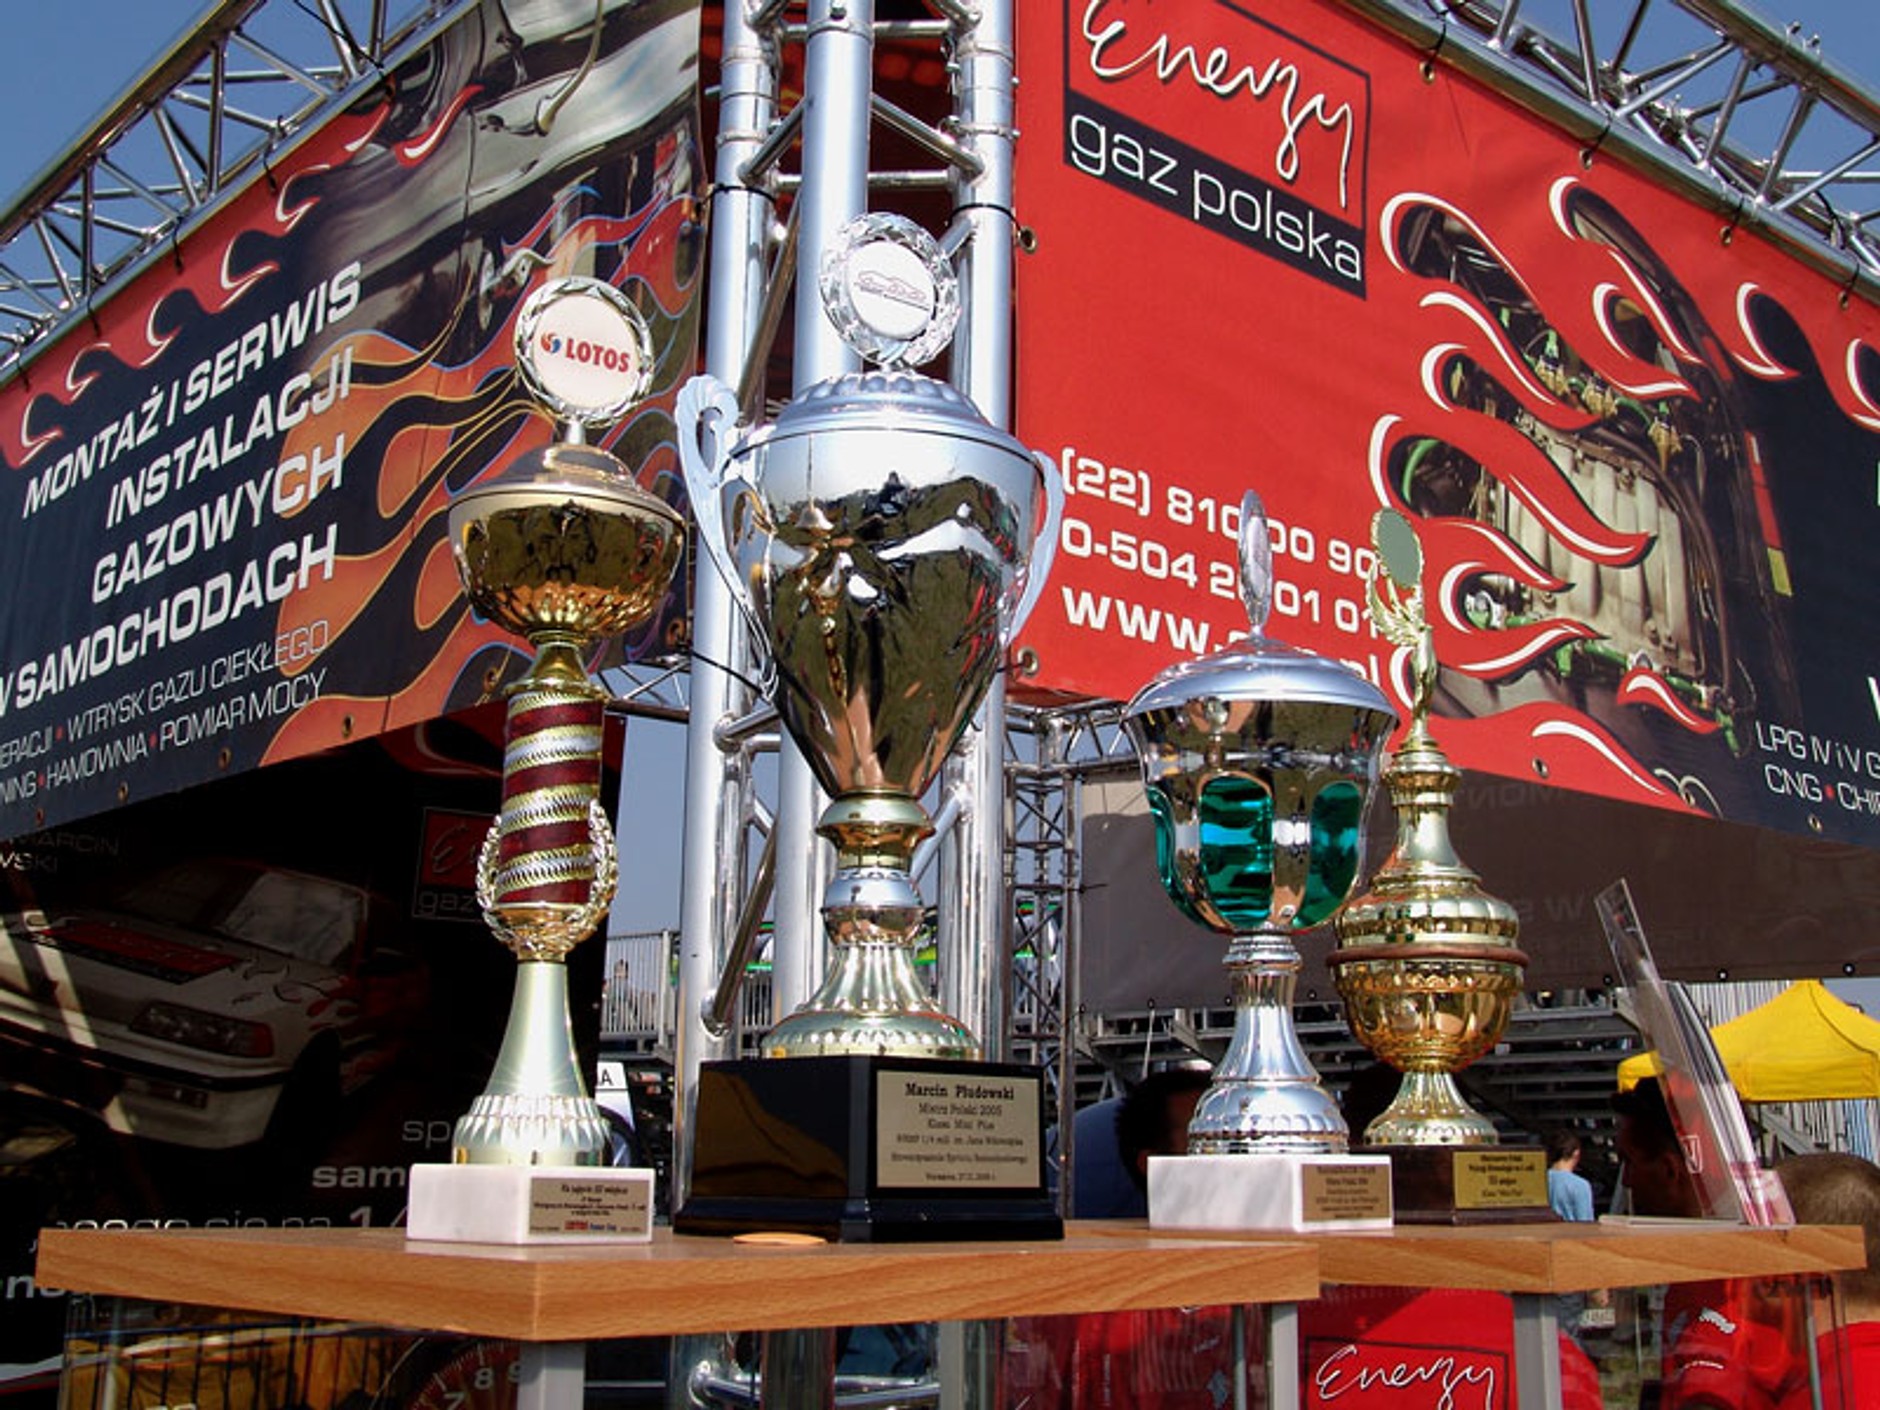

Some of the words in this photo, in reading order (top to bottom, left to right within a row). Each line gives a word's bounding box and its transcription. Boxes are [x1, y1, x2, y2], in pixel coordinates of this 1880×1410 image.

[1071, 114, 1178, 195] gaz
[1193, 170, 1362, 281] polska
[22, 386, 164, 519] MONTAŻ
[183, 261, 362, 417] SERWIS
[565, 338, 630, 373] LOTOS
[106, 346, 354, 529] INSTALACJI
[1061, 447, 1151, 516] (22)
[92, 433, 346, 604] GAZOWYCH
[1061, 517, 1198, 588] 0-504
[1274, 581, 1320, 623] 01
[16, 523, 338, 710] SAMOCHODACH
[46, 731, 148, 791] HAMOWNIA
[160, 697, 247, 751] POMIAR
[249, 667, 328, 723] MOCY
[68, 688, 145, 743] WTRYSK
[149, 669, 205, 713] GAZU
[210, 619, 329, 690] CIEKŁEGO
[1755, 720, 1807, 760] LPG
[1765, 763, 1823, 803] CNG
[904, 1082, 948, 1098] Marcin
[1316, 1344, 1494, 1410] Energy
